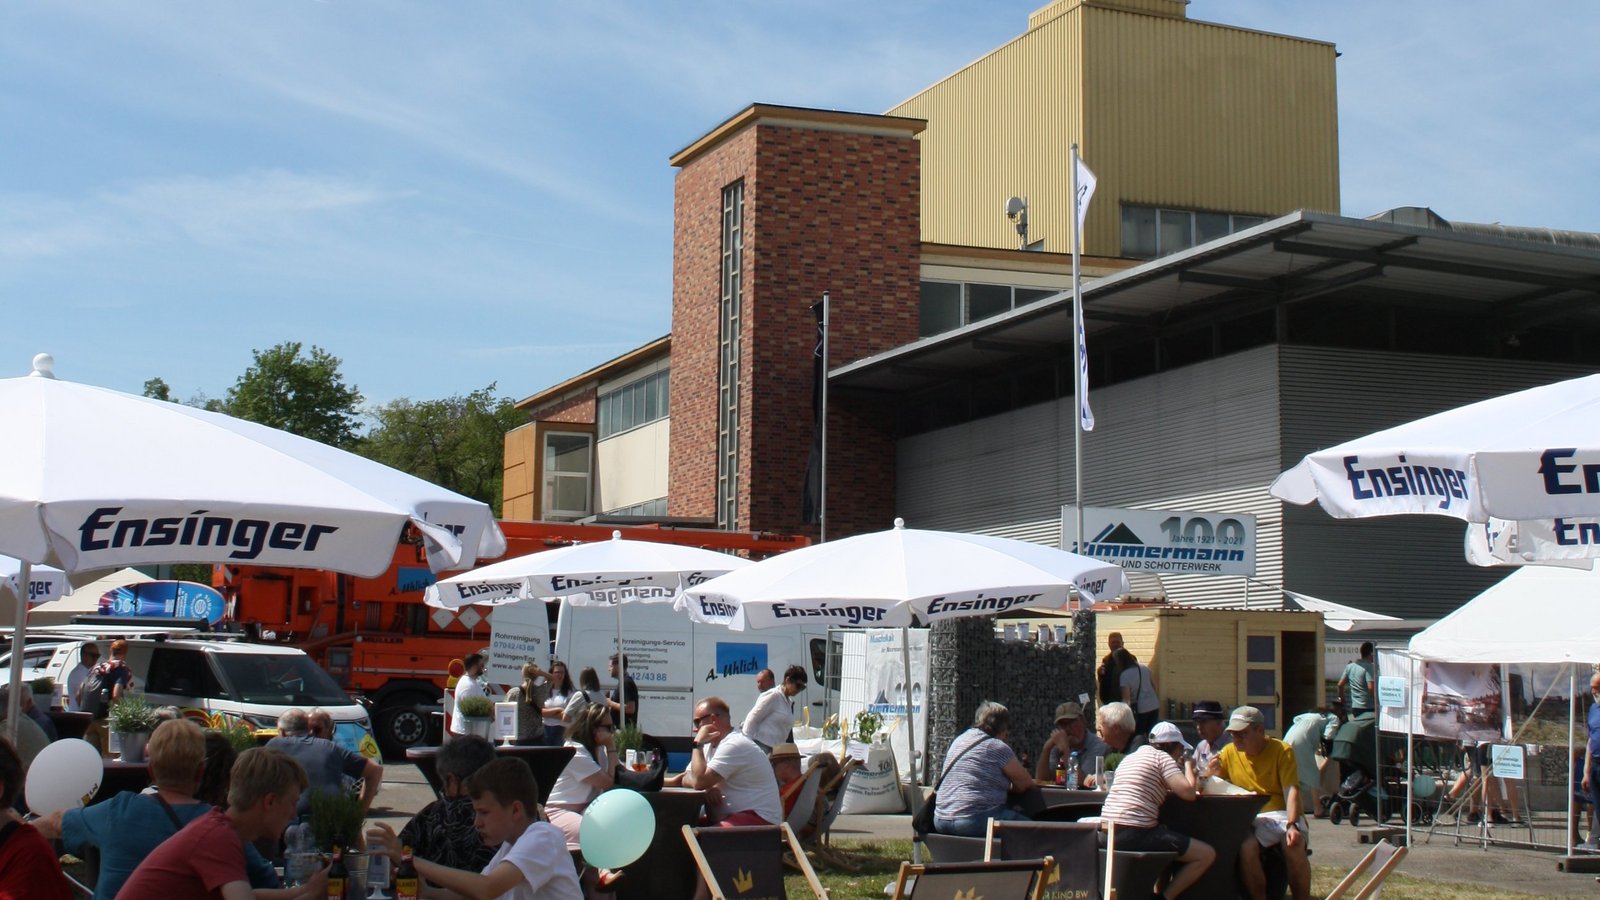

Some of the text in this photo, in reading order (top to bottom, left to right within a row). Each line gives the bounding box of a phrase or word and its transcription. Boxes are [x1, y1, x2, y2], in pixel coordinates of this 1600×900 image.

[1343, 455, 1469, 511] Ensinger
[79, 506, 339, 559] Ensinger
[1160, 516, 1246, 547] 100
[1171, 534, 1194, 545] Jahre
[1197, 536, 1215, 546] 1921
[1223, 536, 1243, 546] 2021
[1121, 560, 1142, 569] UND
[1144, 561, 1222, 572] SCHOTTERWERK
[456, 581, 522, 600] Ensinger
[772, 603, 888, 625] Ensinger
[926, 594, 1044, 615] Ensinger
[495, 633, 541, 645] Rohrreinigung
[613, 638, 686, 648] Rhrreinigungs-Service
[493, 652, 536, 662] Vaihingen/Enz
[705, 656, 759, 682] A. Uhlich
